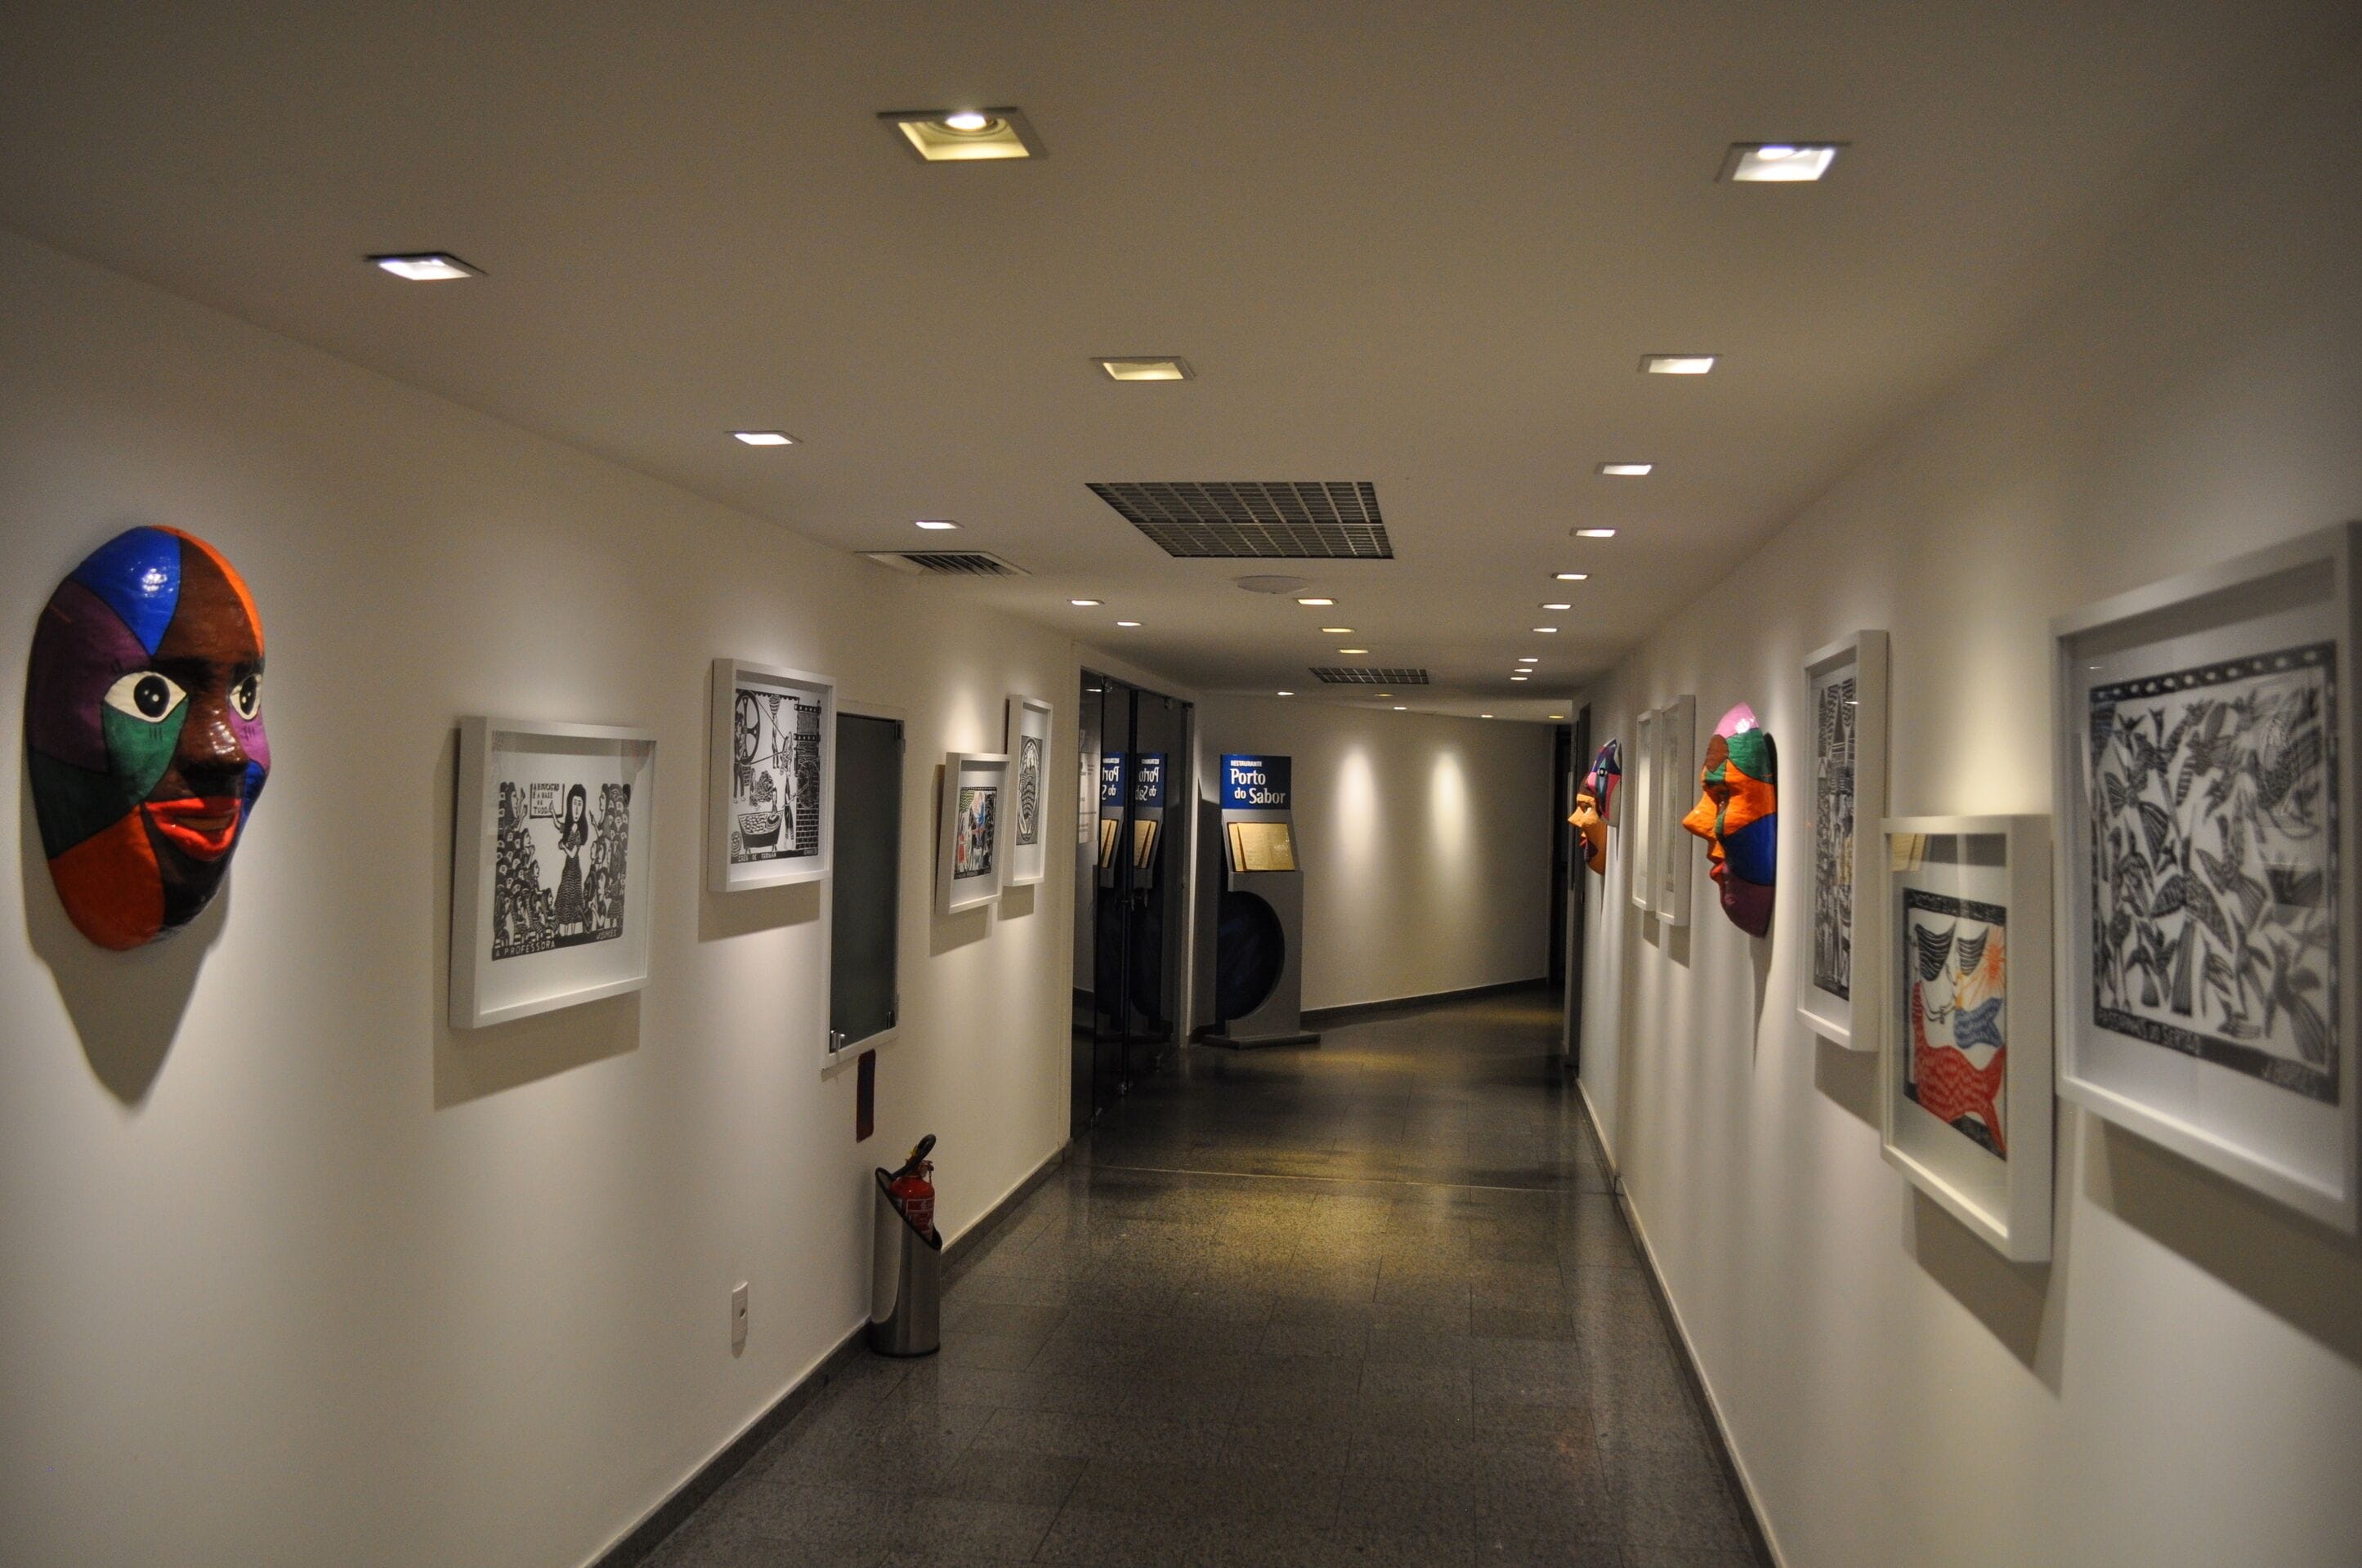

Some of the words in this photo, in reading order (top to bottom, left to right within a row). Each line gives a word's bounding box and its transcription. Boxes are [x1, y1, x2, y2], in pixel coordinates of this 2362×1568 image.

[1229, 768, 1266, 785] Porto
[1234, 787, 1246, 799] do
[1249, 788, 1286, 804] Sabor
[495, 949, 500, 957] A
[504, 940, 556, 955] PROFESSORA
